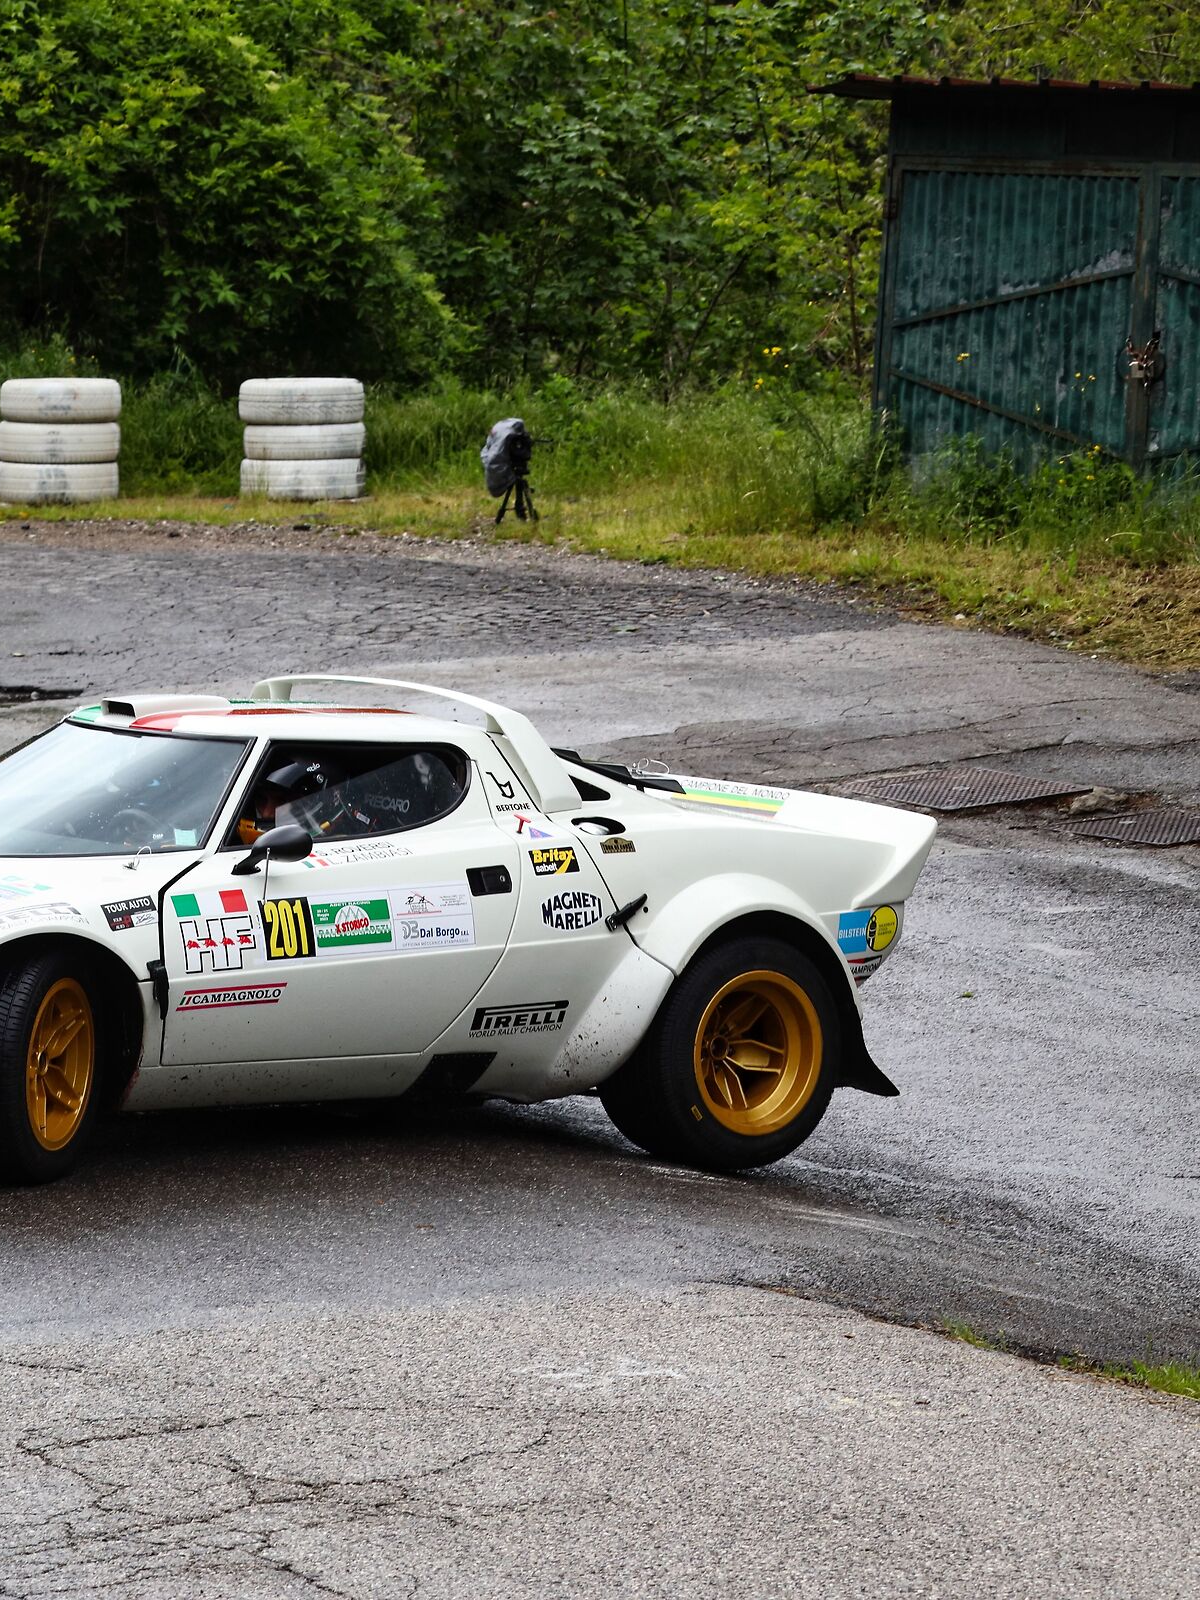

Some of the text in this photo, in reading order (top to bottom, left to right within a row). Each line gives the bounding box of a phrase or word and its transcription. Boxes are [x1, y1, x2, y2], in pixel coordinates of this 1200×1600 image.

[681, 779, 791, 800] CAMPIONE DEL MONDO
[366, 794, 410, 813] RECARO
[495, 803, 531, 812] BERTONE
[346, 847, 414, 863] ZAMBIASI
[532, 848, 576, 864] Britax
[104, 901, 129, 914] TOUR
[129, 897, 151, 910] AUTO
[542, 892, 602, 917] MAGNETI
[341, 917, 370, 933] STORICO
[542, 905, 602, 930] MARELLI
[264, 899, 309, 957] 201
[420, 925, 434, 938] Dal
[435, 927, 460, 939] Borgo
[838, 927, 867, 939] BILSTEIN
[179, 914, 257, 974] HF
[192, 988, 282, 1005] CAMPAGNOLO
[470, 1000, 570, 1031] PIRELLI
[468, 1024, 563, 1039] WORLD RALLY CHAMPION
